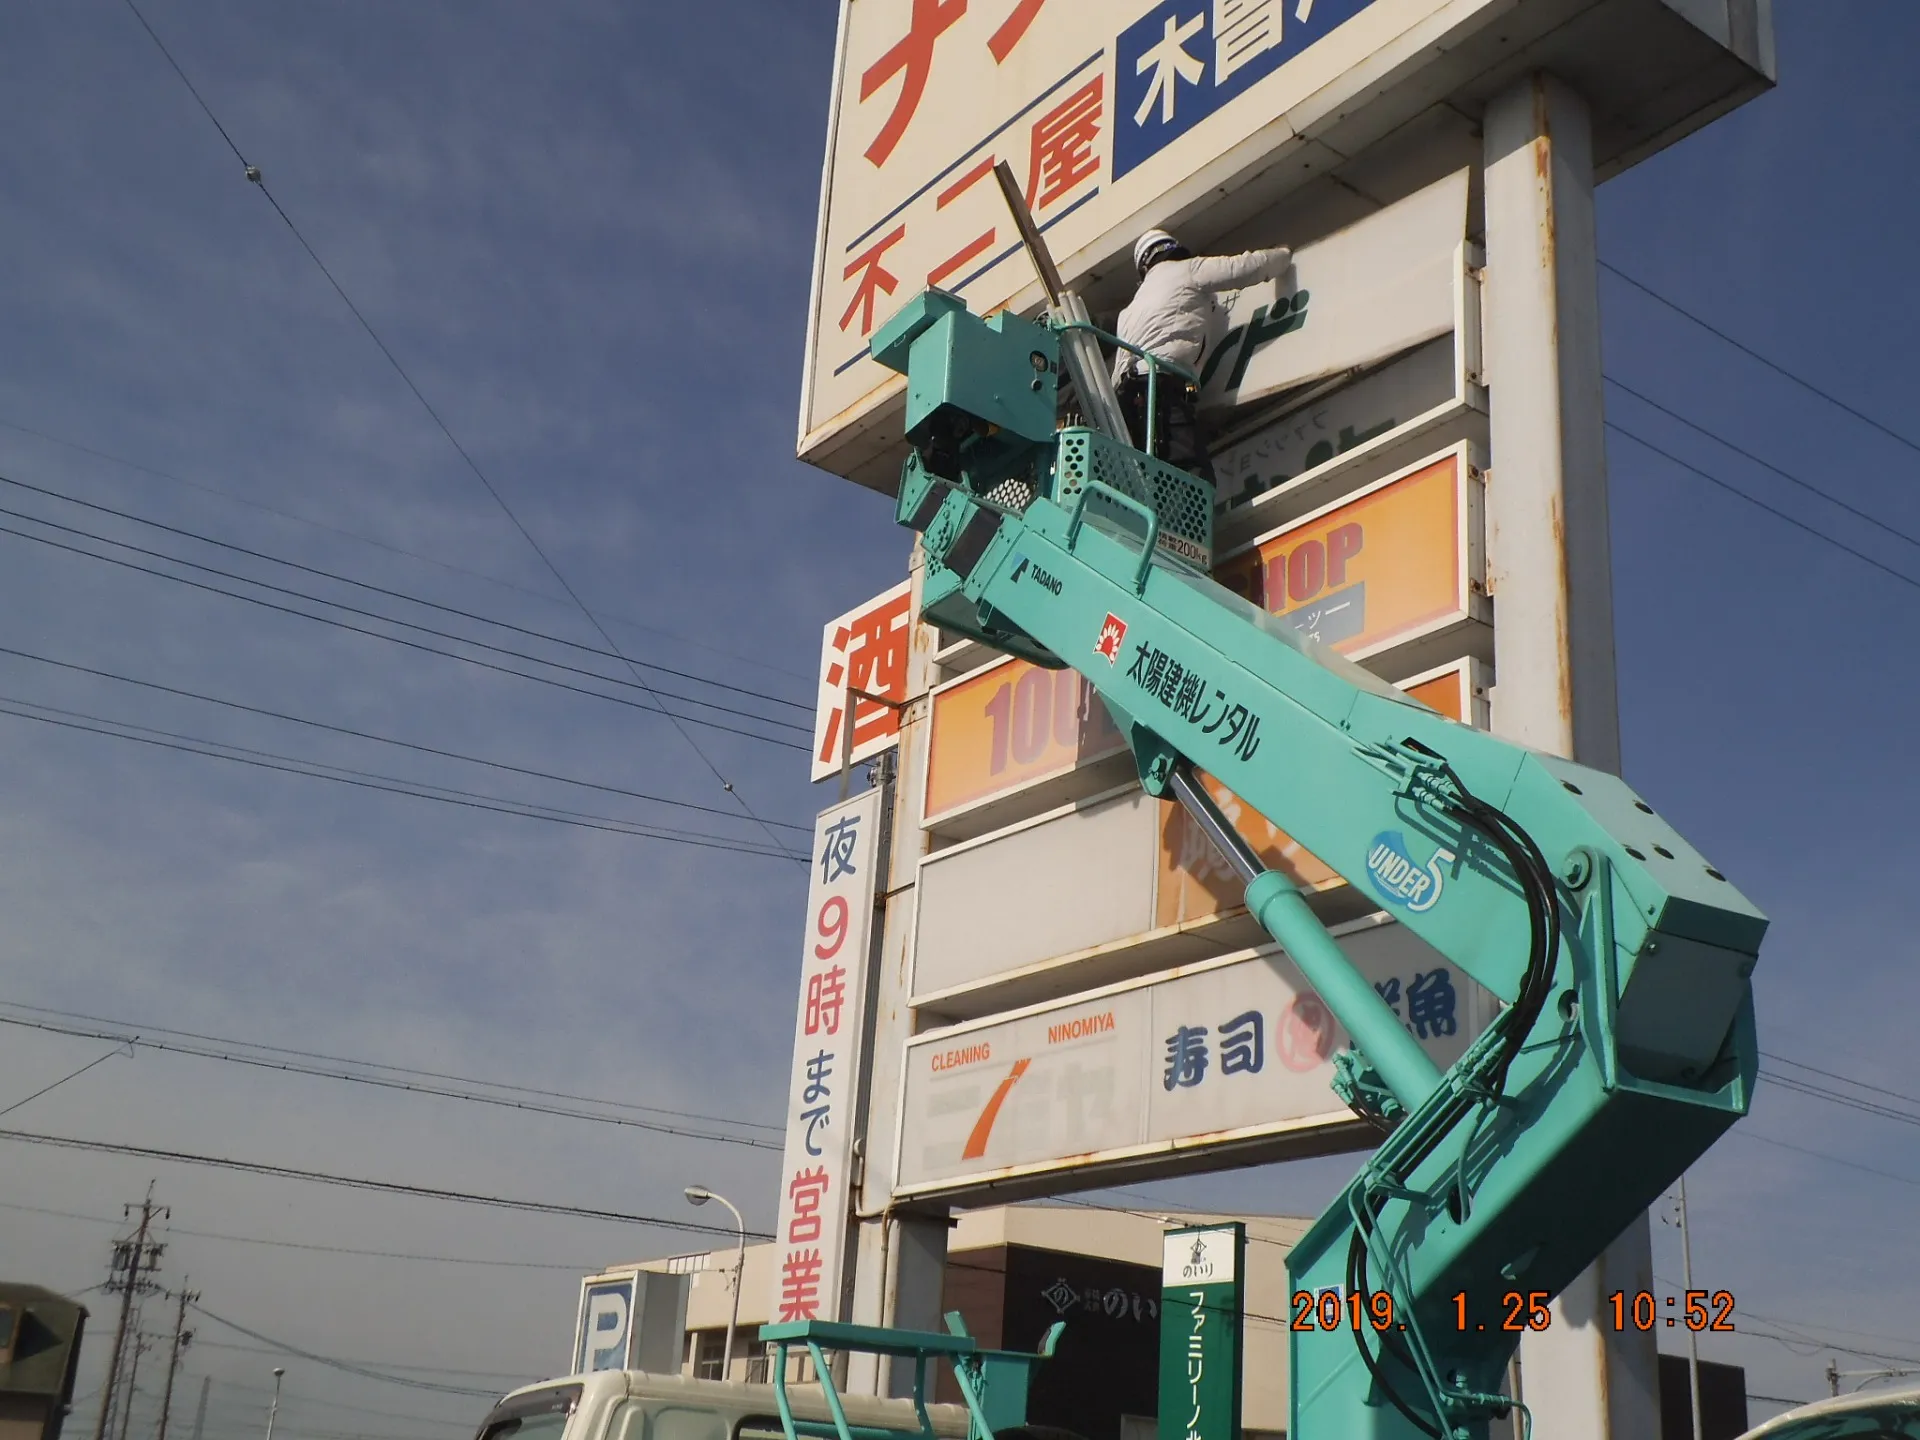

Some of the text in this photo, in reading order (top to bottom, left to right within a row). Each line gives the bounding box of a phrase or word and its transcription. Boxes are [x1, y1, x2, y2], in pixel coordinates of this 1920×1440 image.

[1133, 0, 1314, 128] 木曽
[838, 72, 1104, 337] 不二屋
[1031, 563, 1063, 596] TADANO
[819, 591, 912, 763] 酒
[1126, 640, 1261, 762] 太陽建機レンタル
[1368, 843, 1456, 912] UNDER 5
[779, 816, 862, 1323] 夜9時まで営業
[931, 1012, 1115, 1072] CLEANING NINOMIYA
[1163, 1010, 1265, 1092] 寿司
[1182, 1261, 1214, 1279] のいり
[583, 1292, 627, 1375] P
